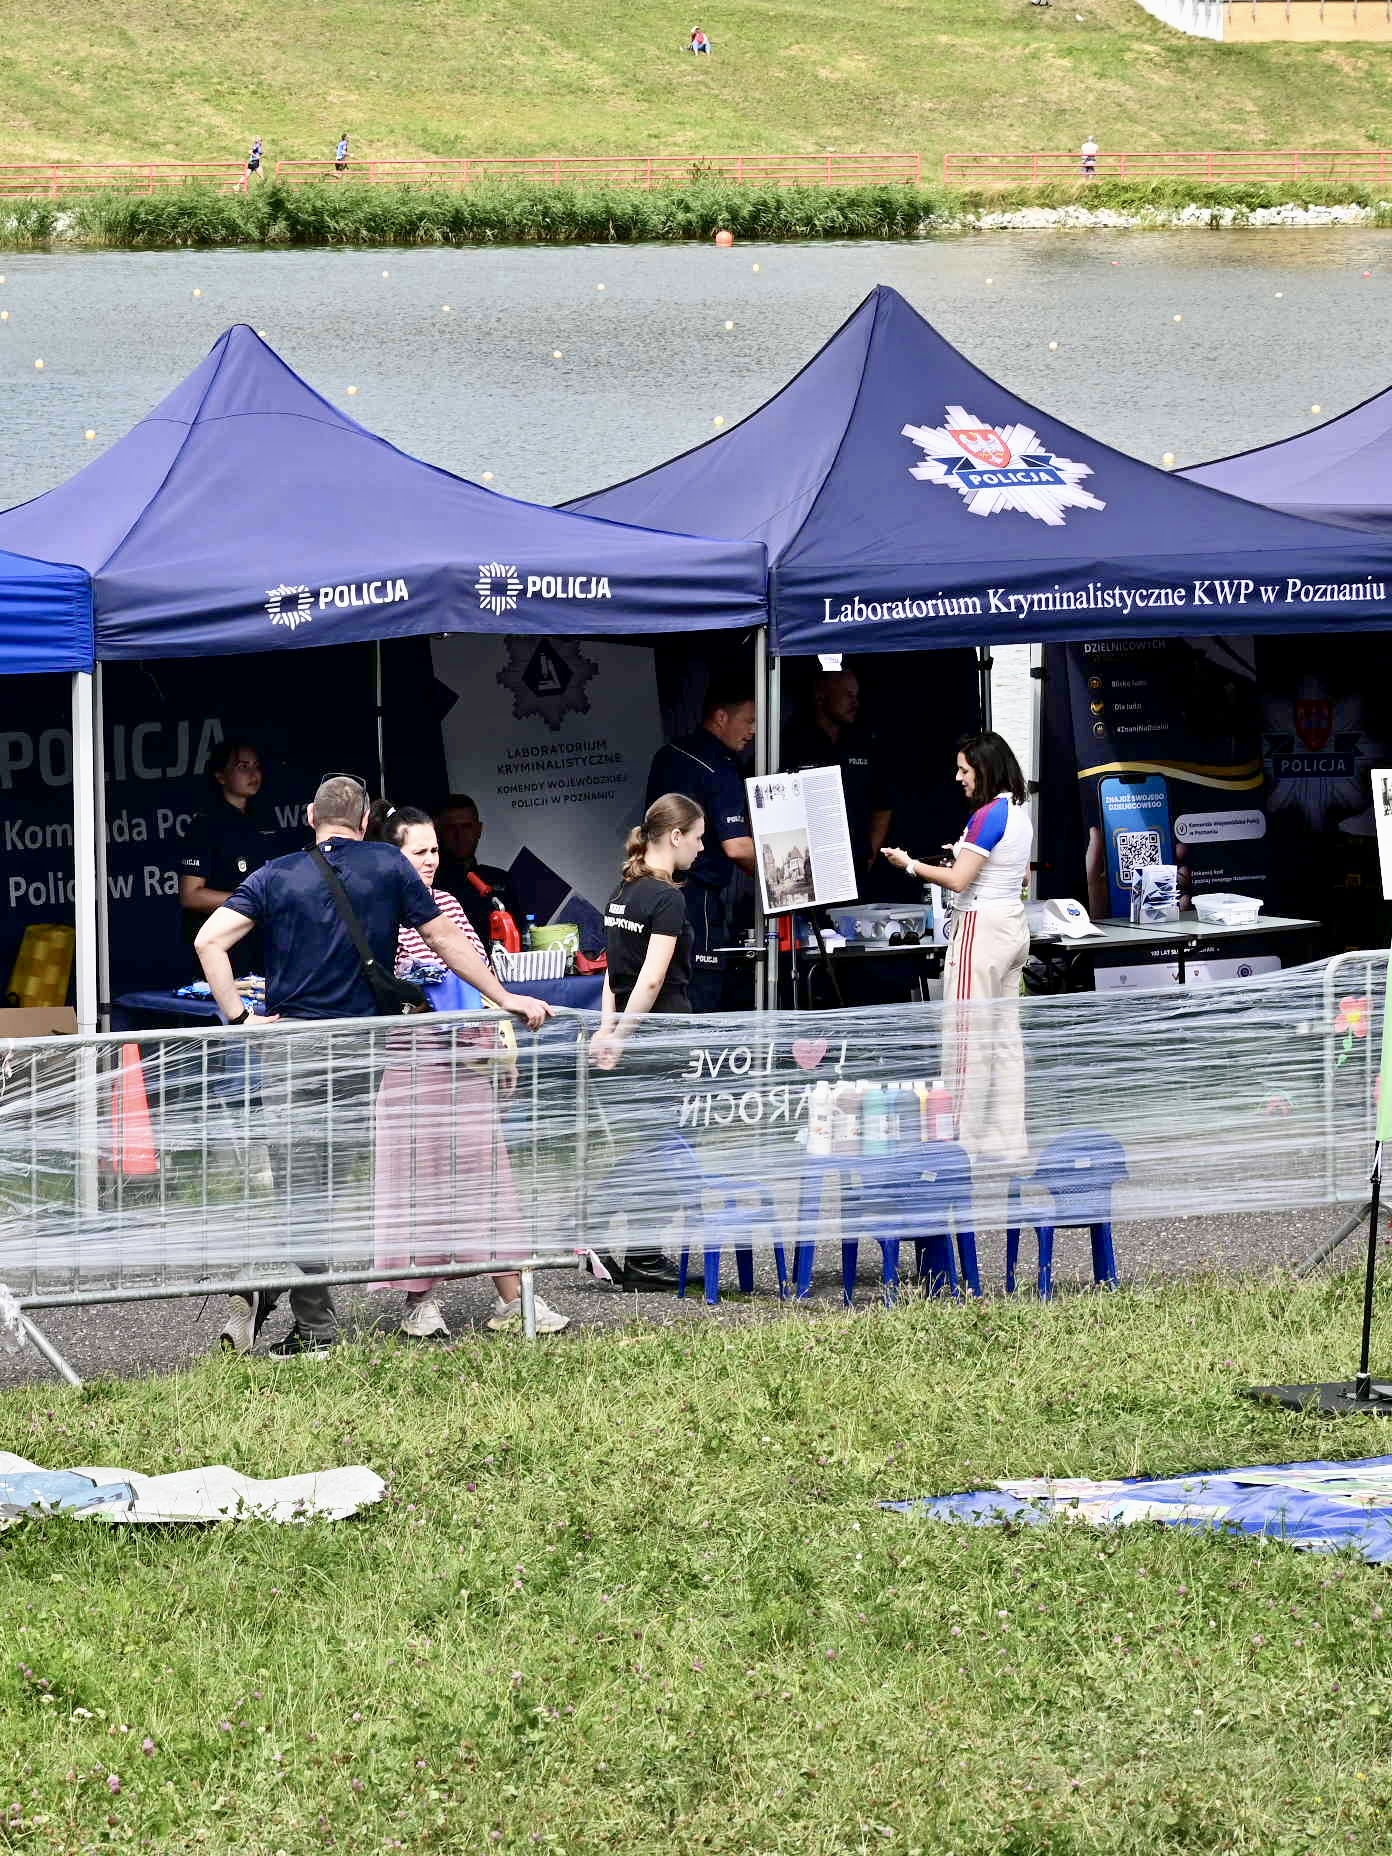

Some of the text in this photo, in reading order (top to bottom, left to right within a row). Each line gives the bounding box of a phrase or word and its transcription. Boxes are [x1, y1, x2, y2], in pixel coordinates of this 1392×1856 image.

[968, 471, 1055, 486] POLICJA
[319, 579, 409, 610] POLICJA
[526, 575, 612, 600] POLICJA
[822, 575, 1387, 624] Laboratorium Kryminalistyczne KWP w Poznaniu
[505, 739, 608, 759] LABORATORIUM
[497, 752, 623, 776] KRYMINALISTYCZNE
[1280, 758, 1348, 773] POLICJA
[4, 809, 148, 851] Komda
